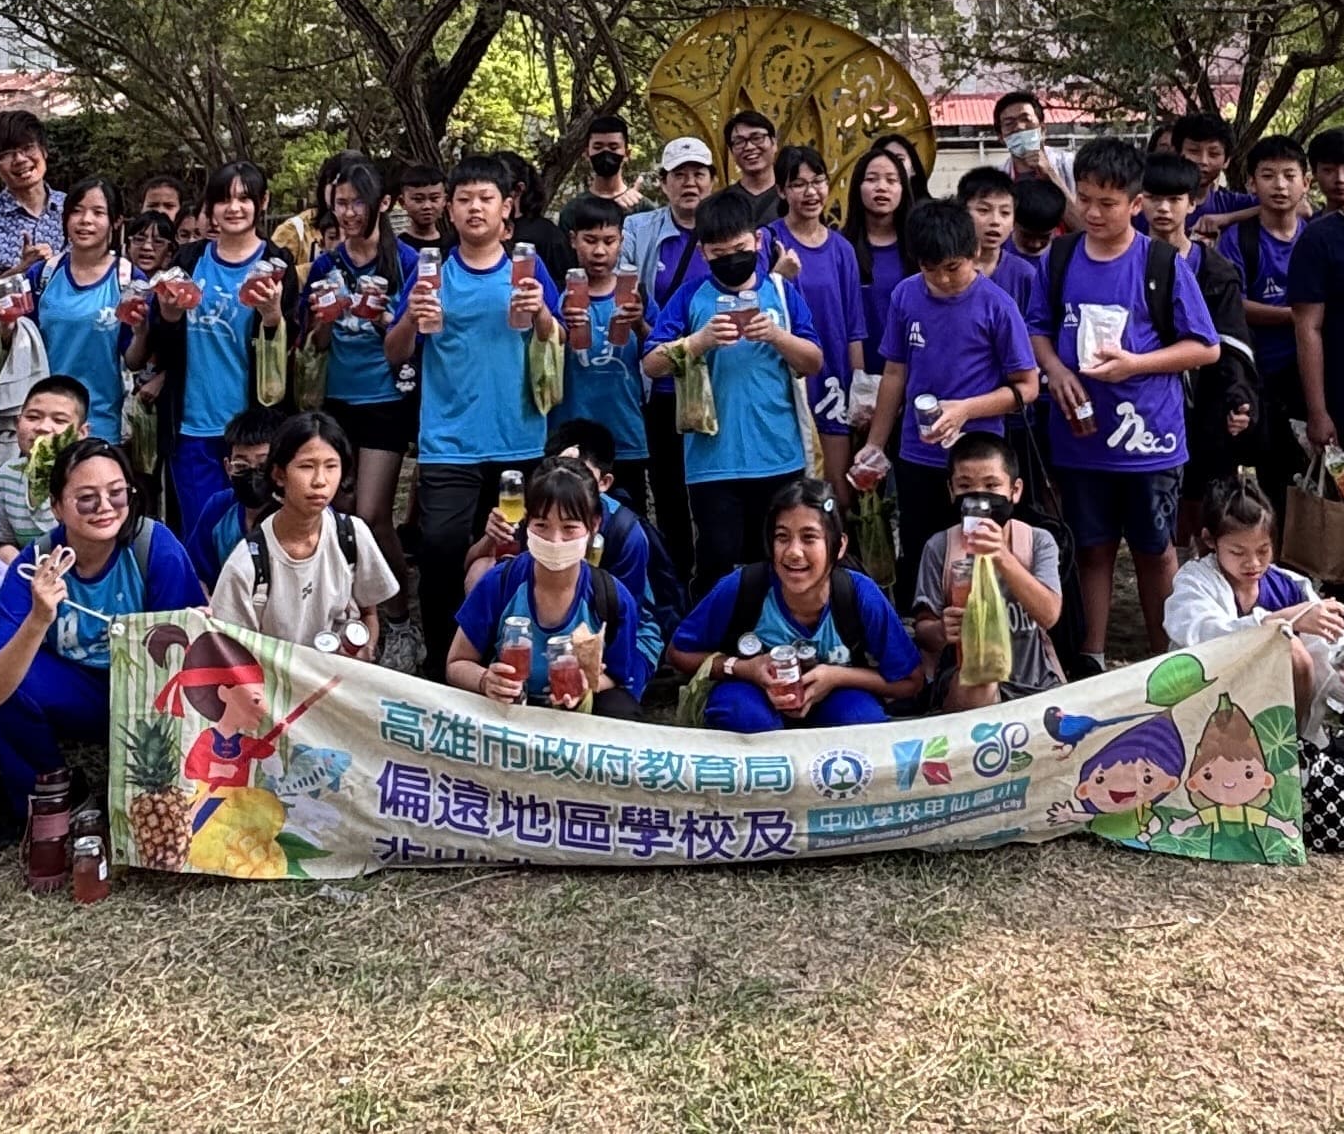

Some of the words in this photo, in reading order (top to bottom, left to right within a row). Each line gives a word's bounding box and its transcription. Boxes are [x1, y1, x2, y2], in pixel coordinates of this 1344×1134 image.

[379, 699, 793, 793] 高雄市政府教育局
[376, 760, 798, 859] 偏遠地區學校及
[820, 783, 1018, 832] 中心學校甲仙國小
[1002, 799, 1022, 809] City
